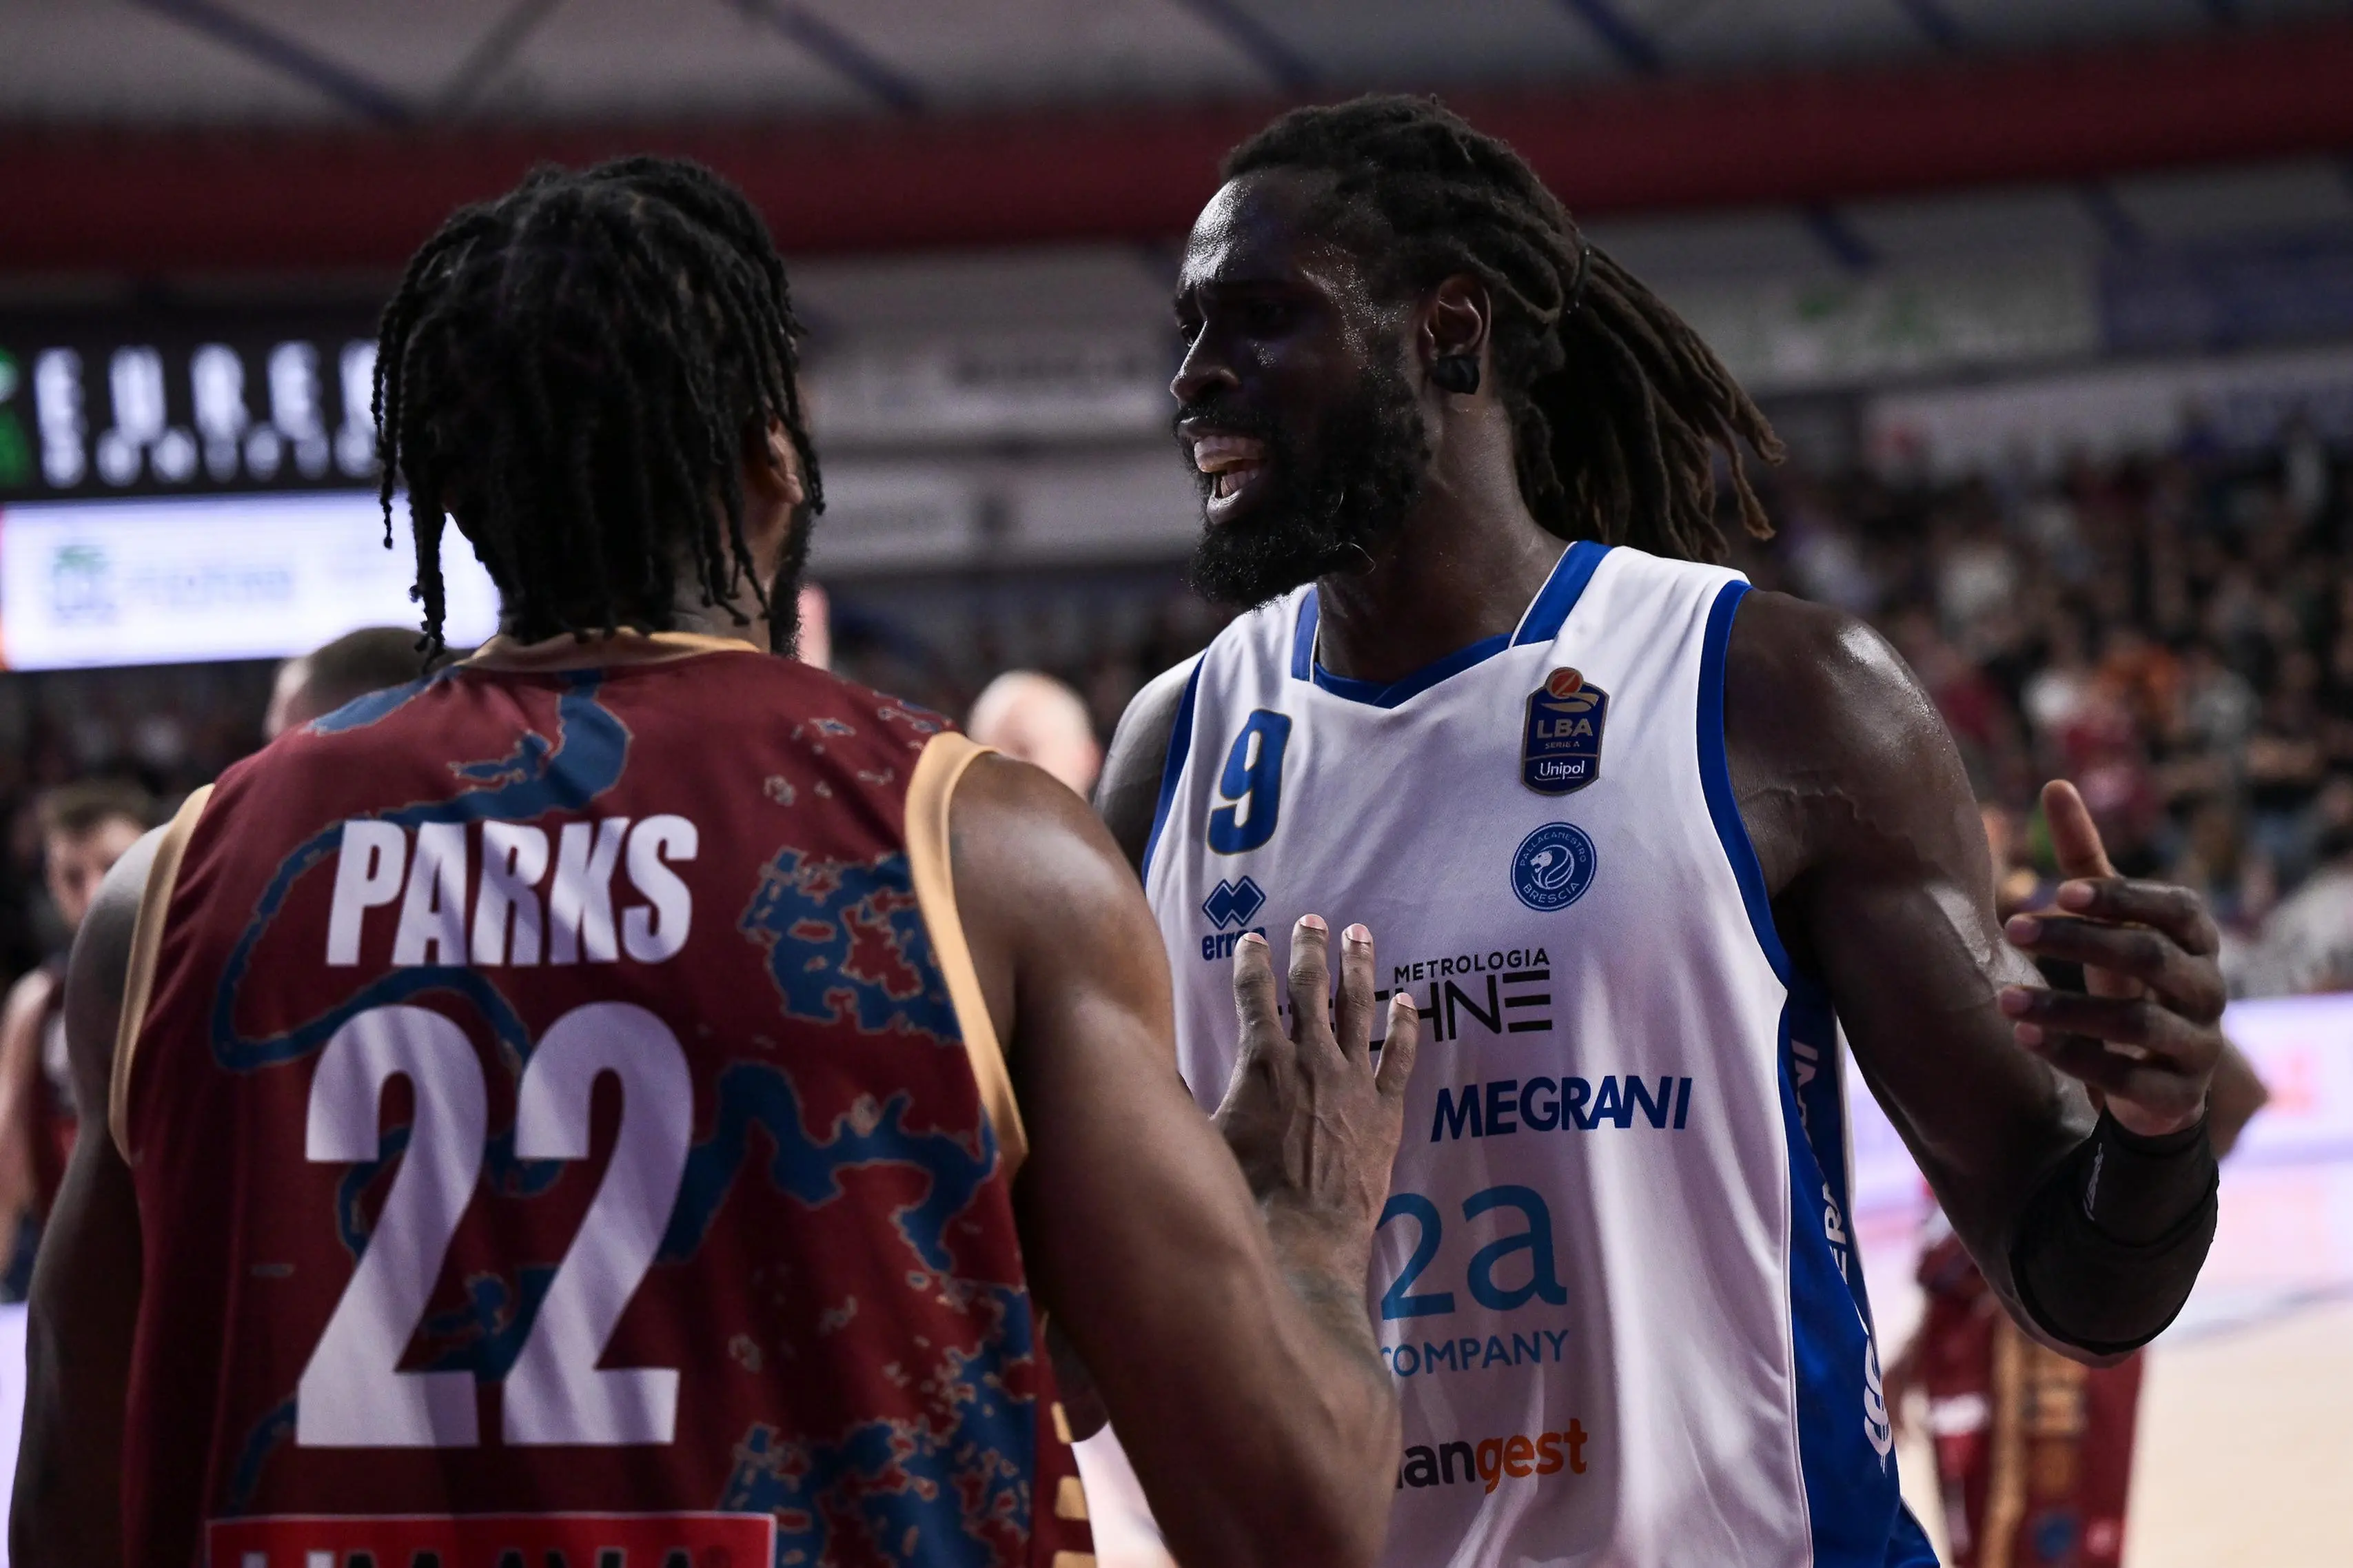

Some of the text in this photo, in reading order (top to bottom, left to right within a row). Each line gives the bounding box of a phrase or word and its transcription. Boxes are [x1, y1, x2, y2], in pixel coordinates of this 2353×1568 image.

[1536, 718, 1593, 739] LBA
[1545, 742, 1571, 750] SERIE
[1207, 709, 1292, 855] 9
[1540, 760, 1585, 780] Unipol
[1520, 831, 1587, 866] PALLACANESTRO
[325, 813, 699, 966] PARKS
[1523, 882, 1580, 904] BRESCIA
[1201, 926, 1267, 961] err
[1394, 948, 1550, 984] METROLOGIA
[1430, 1075, 1693, 1143] MEGRANI
[295, 1001, 694, 1447] 22
[1376, 1185, 1567, 1321] 2a
[1396, 1418, 1588, 1495] angest
